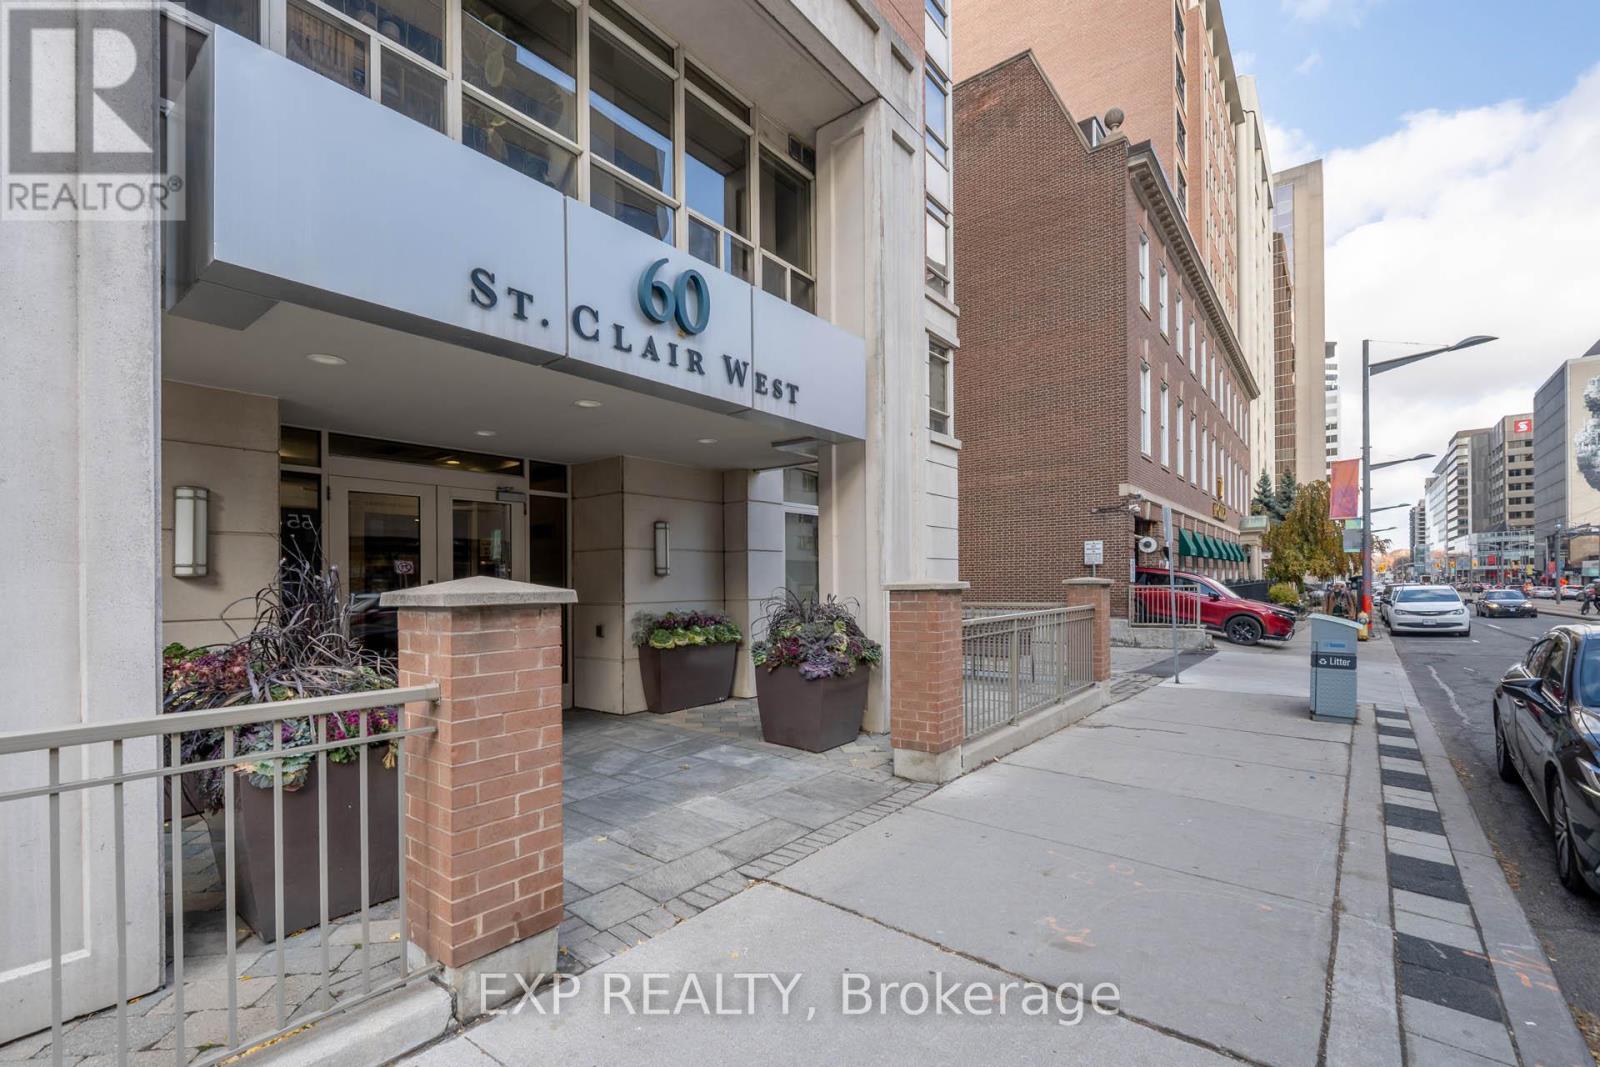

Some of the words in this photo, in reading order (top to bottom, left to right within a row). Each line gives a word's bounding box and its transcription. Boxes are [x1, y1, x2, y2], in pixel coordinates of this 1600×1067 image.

[469, 267, 550, 328] ST.
[571, 304, 706, 376] CLAIR
[723, 354, 800, 405] WEST
[638, 257, 711, 336] 60
[1329, 656, 1351, 667] Litter
